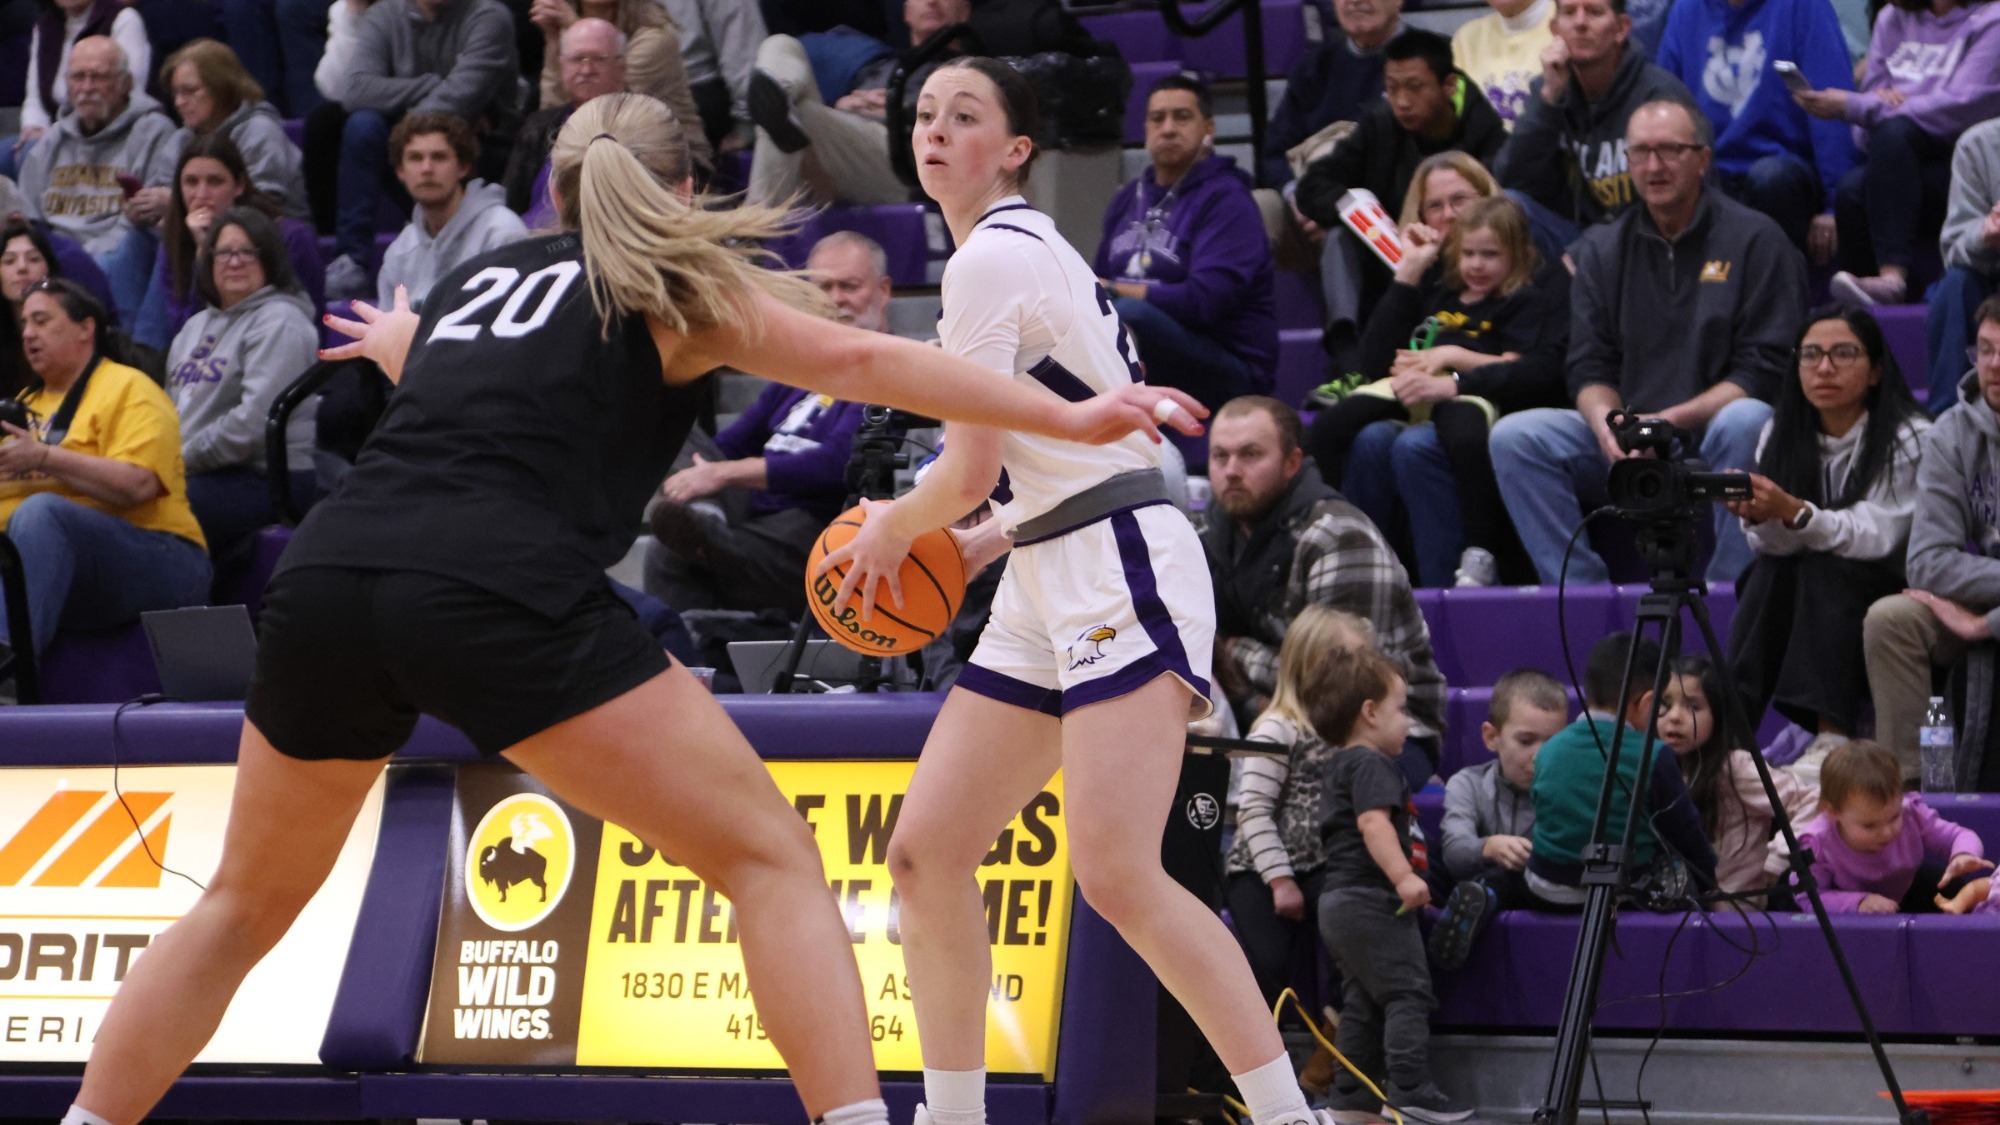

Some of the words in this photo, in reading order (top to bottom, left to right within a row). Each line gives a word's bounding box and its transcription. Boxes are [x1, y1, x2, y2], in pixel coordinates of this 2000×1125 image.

[425, 259, 582, 345] 20
[459, 940, 559, 964] BUFFALO
[457, 965, 556, 1006] WILD
[621, 972, 684, 999] 1830
[693, 972, 709, 999] E
[6, 1016, 96, 1043] ERI
[453, 1008, 551, 1040] WINGS
